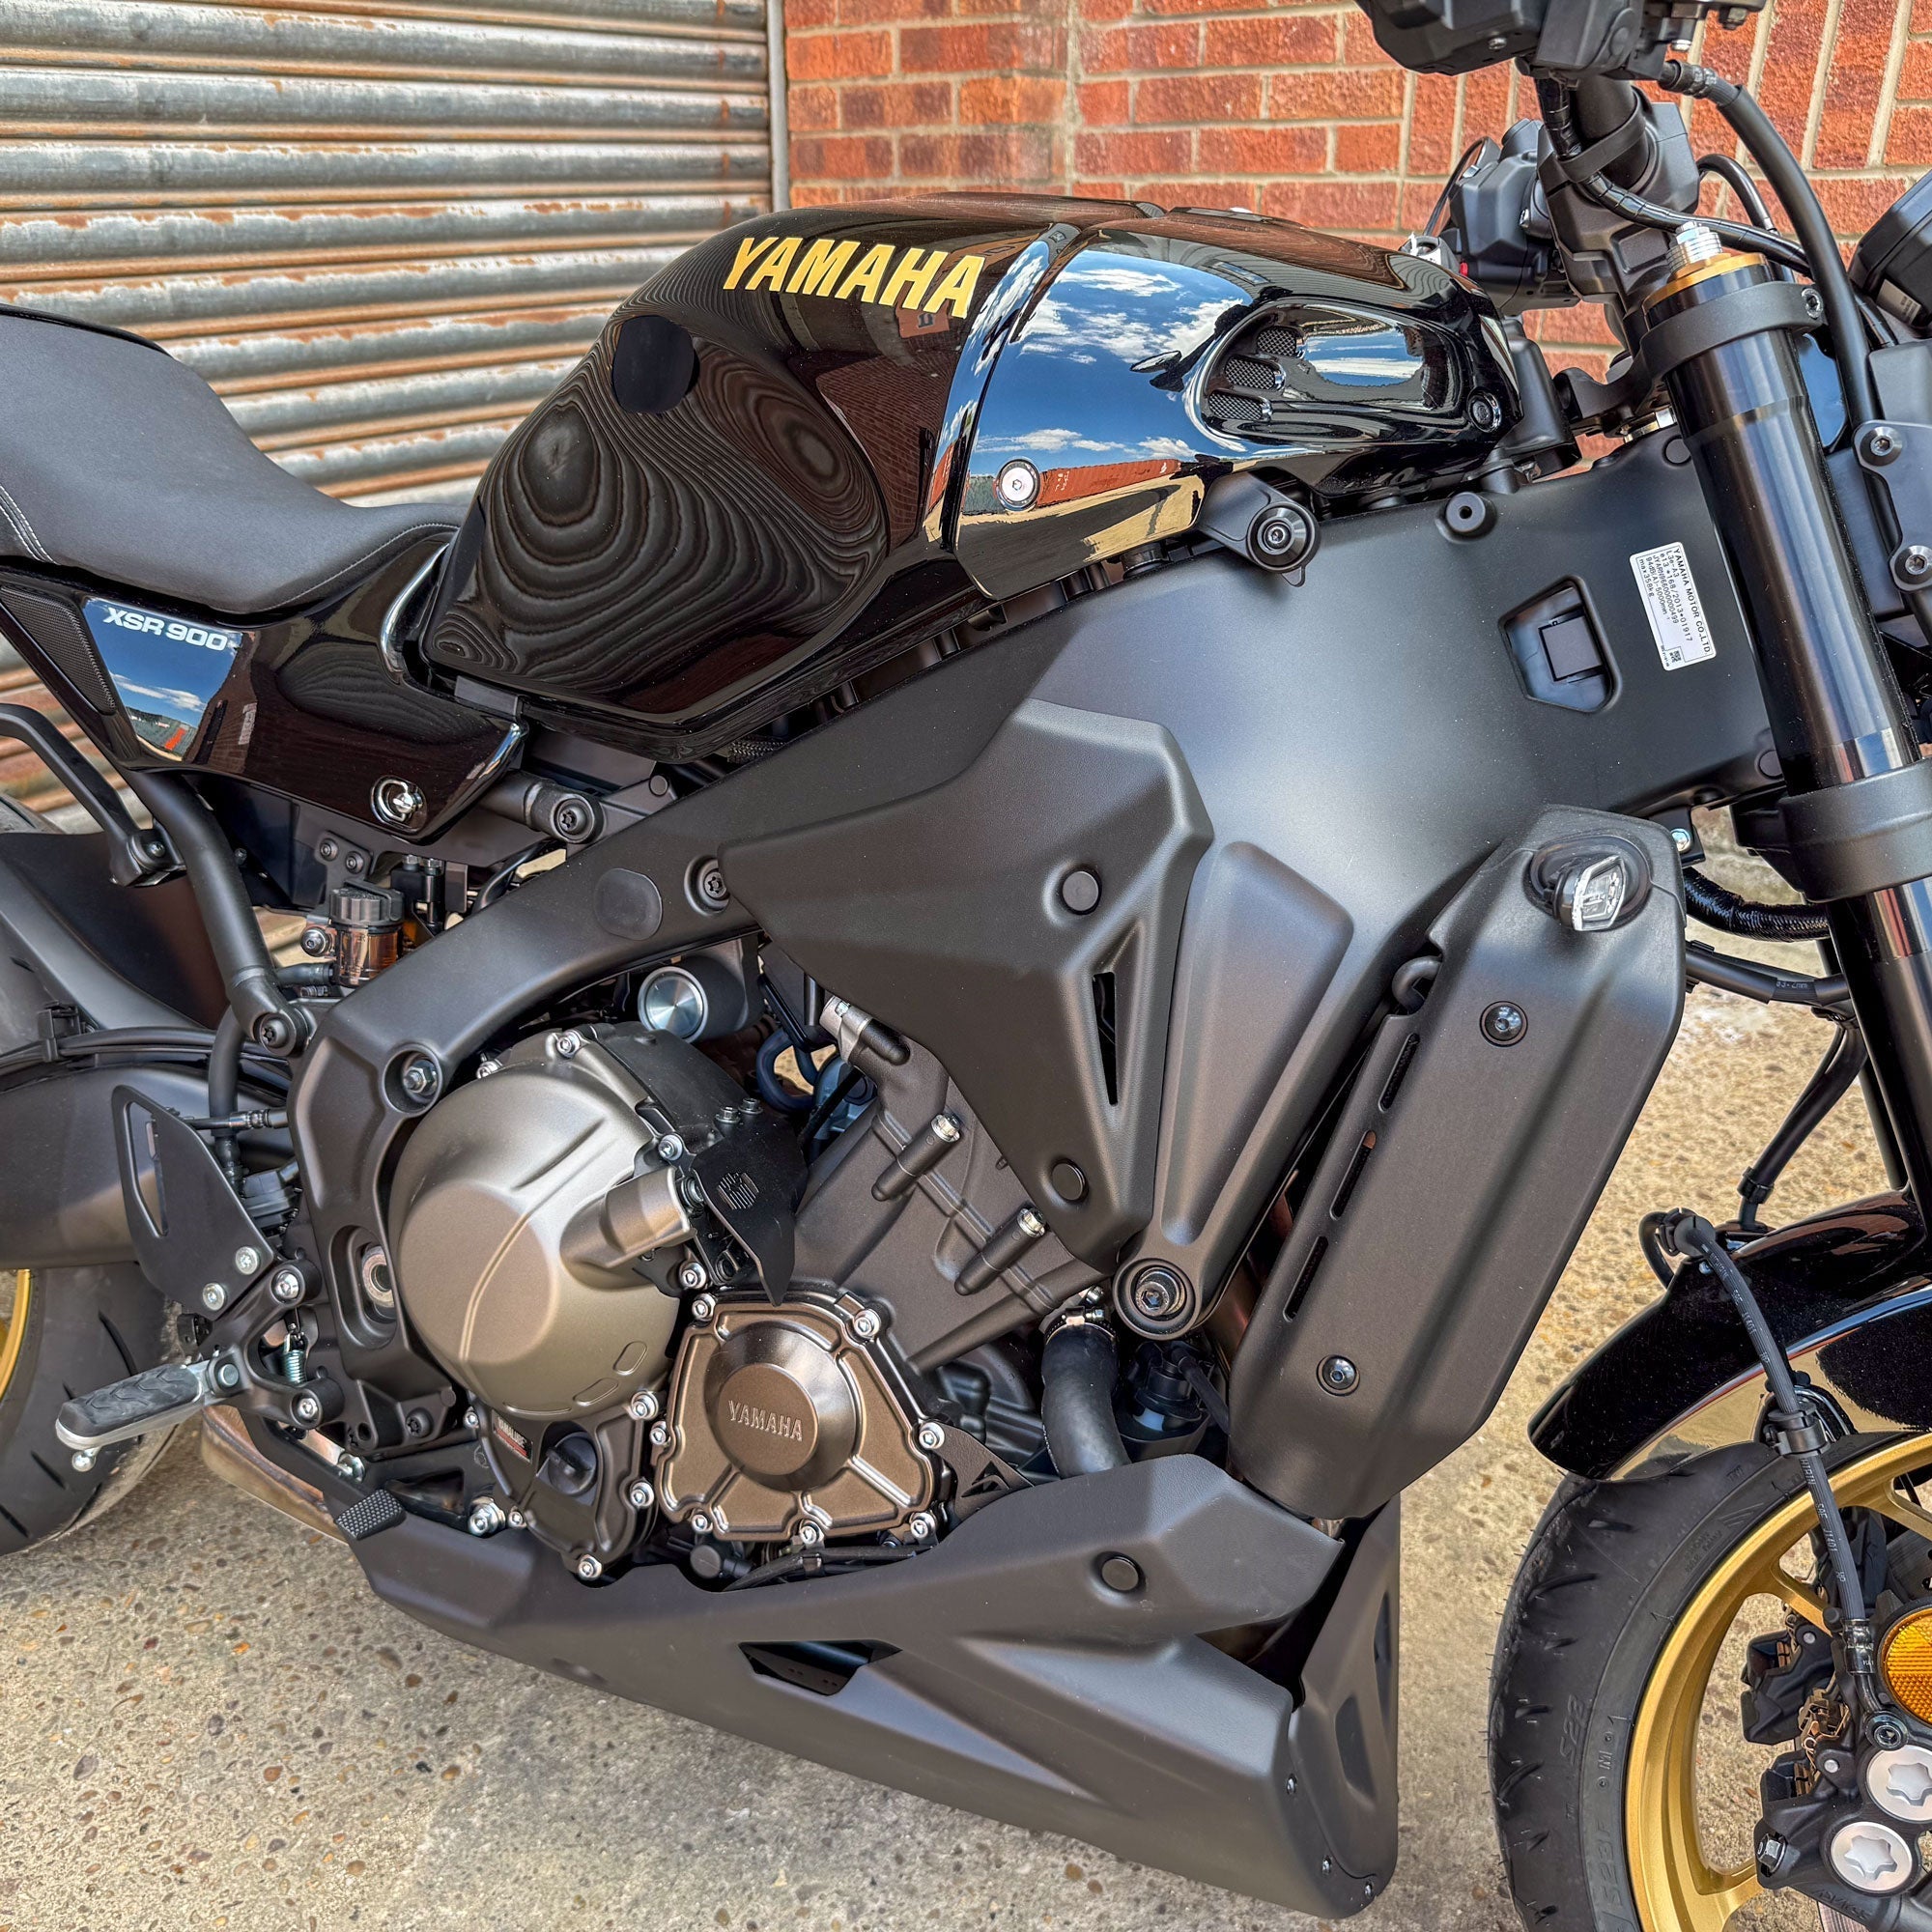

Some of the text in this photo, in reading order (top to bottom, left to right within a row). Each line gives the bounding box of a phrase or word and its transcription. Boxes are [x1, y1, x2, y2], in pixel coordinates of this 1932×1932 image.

[723, 237, 985, 319] YAMAHA
[1659, 552, 1669, 567] e13
[1665, 550, 1679, 578] L3e-A3
[1672, 548, 1690, 585] YAMAHA
[1685, 587, 1700, 618] MOTOR
[728, 1400, 803, 1442] YAMAHA
